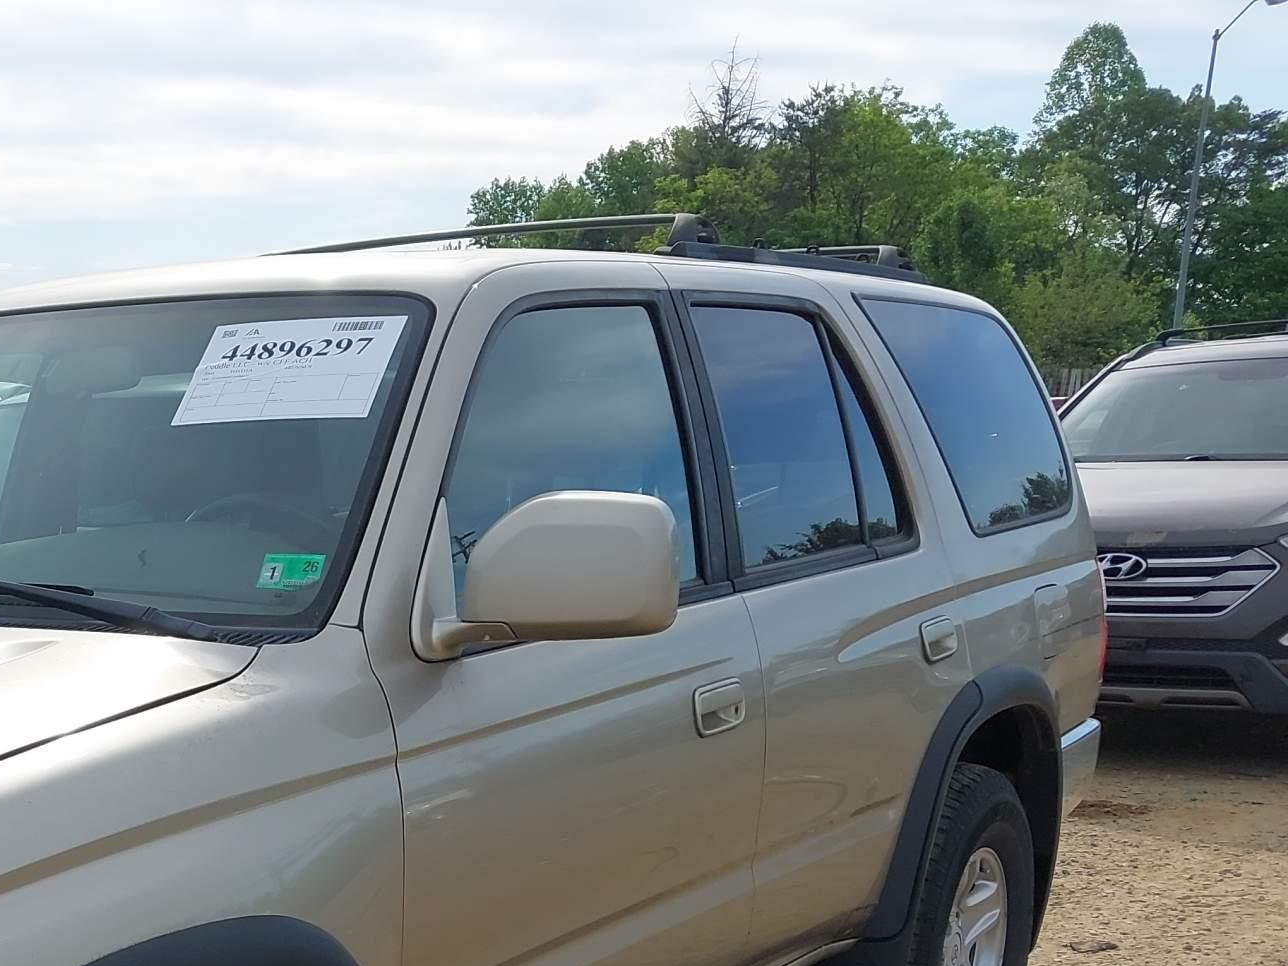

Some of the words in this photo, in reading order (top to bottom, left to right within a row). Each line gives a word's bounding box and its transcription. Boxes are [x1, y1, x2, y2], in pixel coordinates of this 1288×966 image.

[221, 337, 374, 362] 44896297
[270, 565, 277, 580] 1
[302, 561, 319, 573] 26
